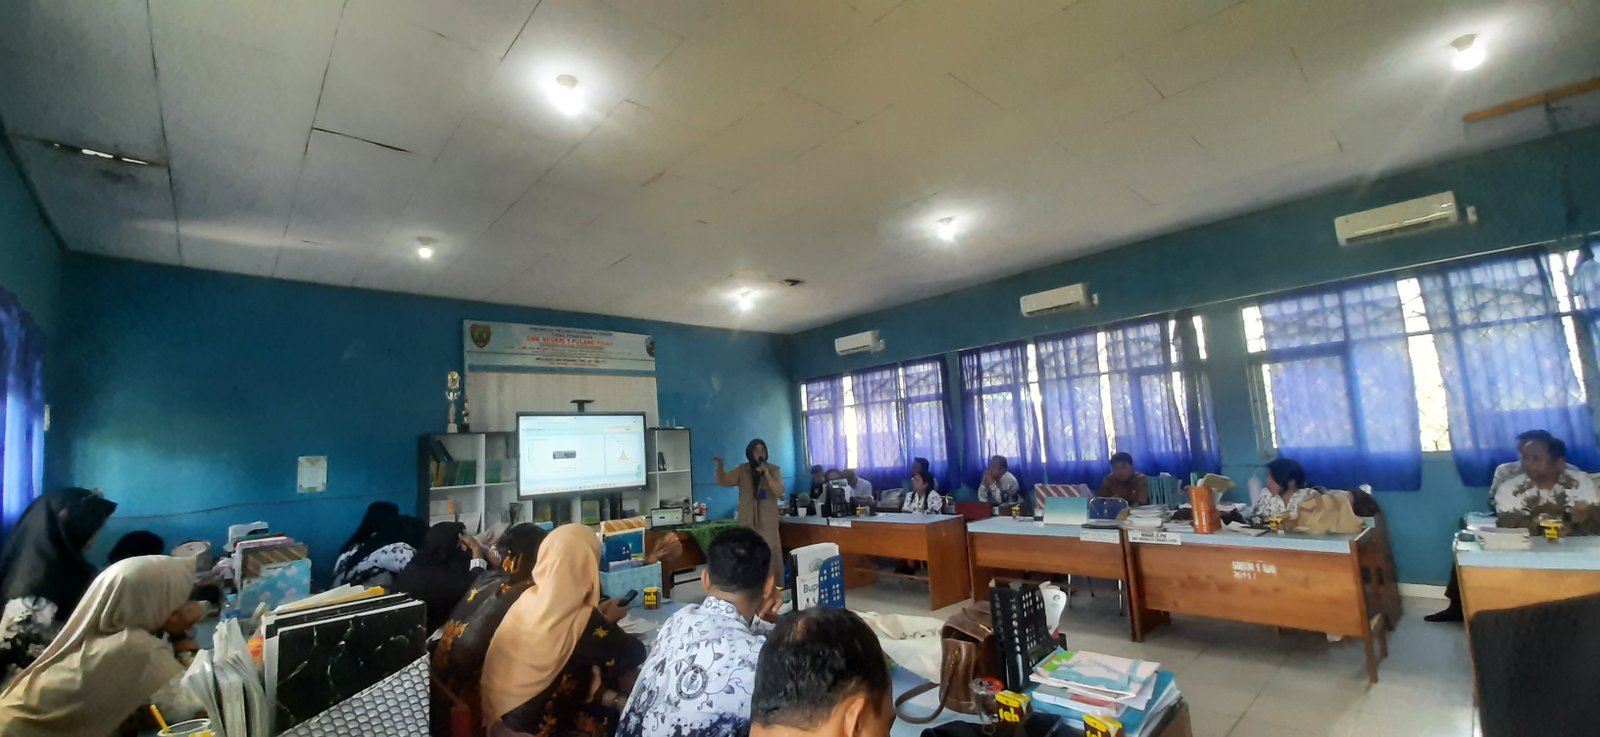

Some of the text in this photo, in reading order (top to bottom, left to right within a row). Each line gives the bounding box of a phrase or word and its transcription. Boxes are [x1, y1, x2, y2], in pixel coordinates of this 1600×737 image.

[527, 335, 540, 343] SMK
[543, 336, 565, 345] NEGERI
[998, 707, 1019, 722] teh
